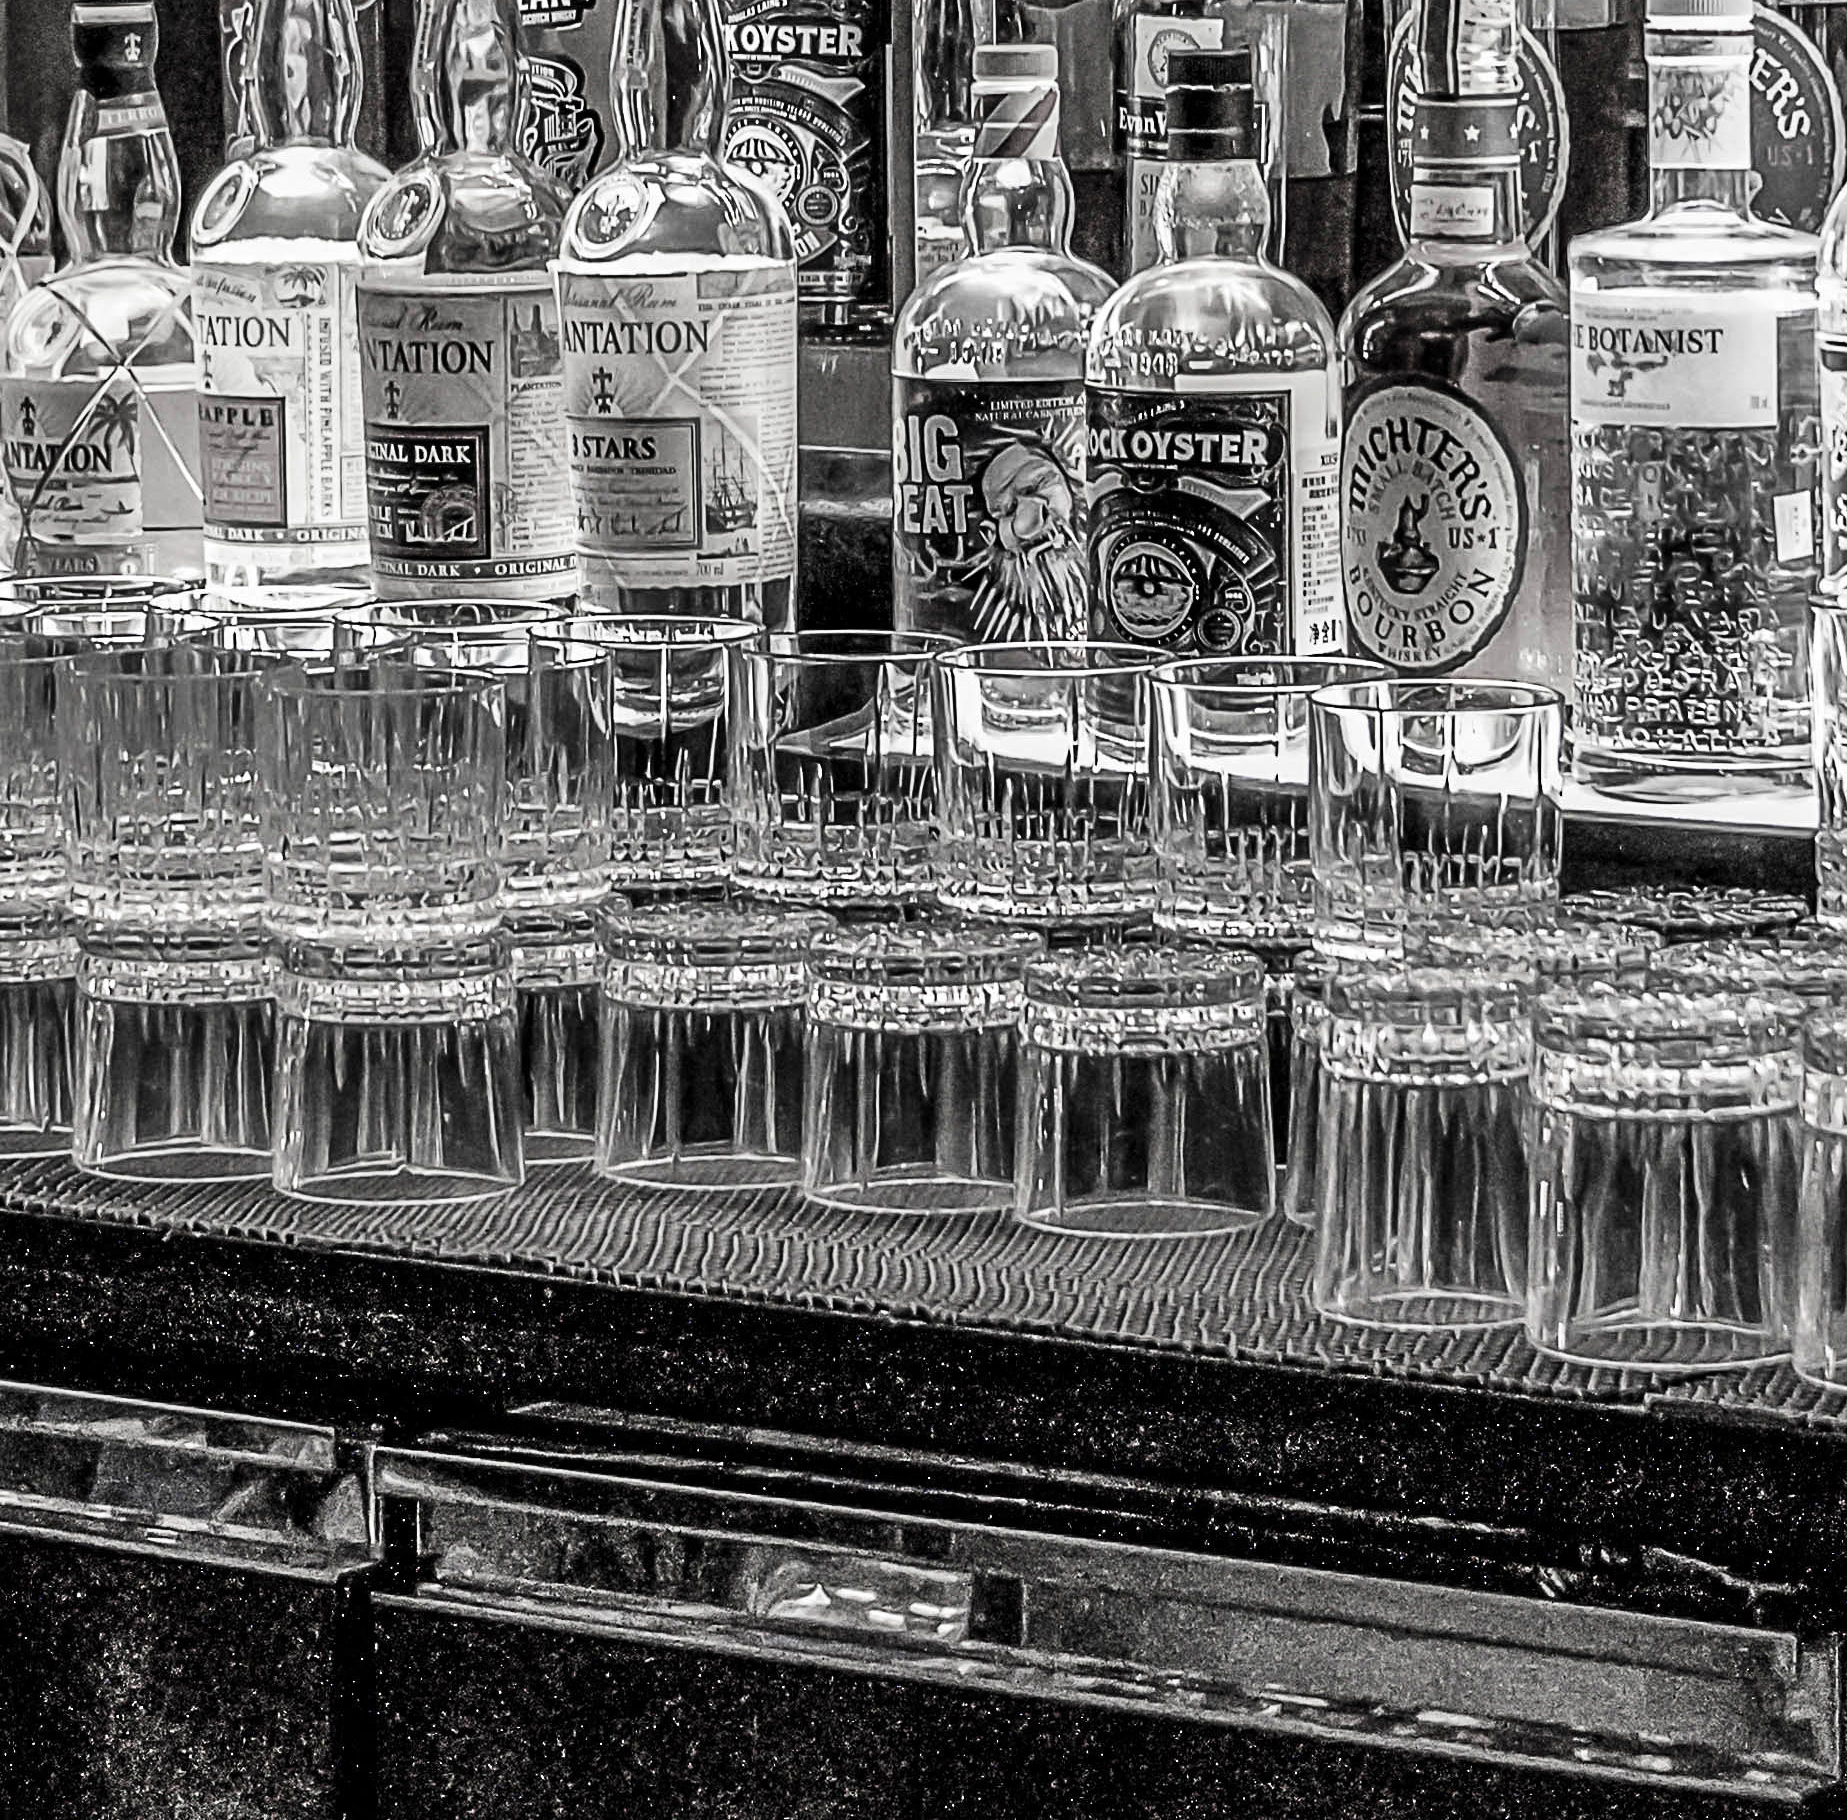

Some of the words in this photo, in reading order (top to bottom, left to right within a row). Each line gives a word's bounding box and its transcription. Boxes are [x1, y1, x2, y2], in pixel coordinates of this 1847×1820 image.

[739, 24, 864, 58] OYSTER
[1588, 325, 1725, 355] BOTANIST
[990, 399, 1034, 412] LIMITED
[414, 444, 472, 464] DARK
[583, 435, 657, 460] STARS
[1087, 430, 1128, 459] OCK
[1129, 429, 1270, 467] OYSTER
[1350, 415, 1493, 522] MICHTER'S
[416, 564, 460, 578] DARK
[494, 559, 568, 576] ORIGINAL
[1349, 566, 1496, 649] BOURBON
